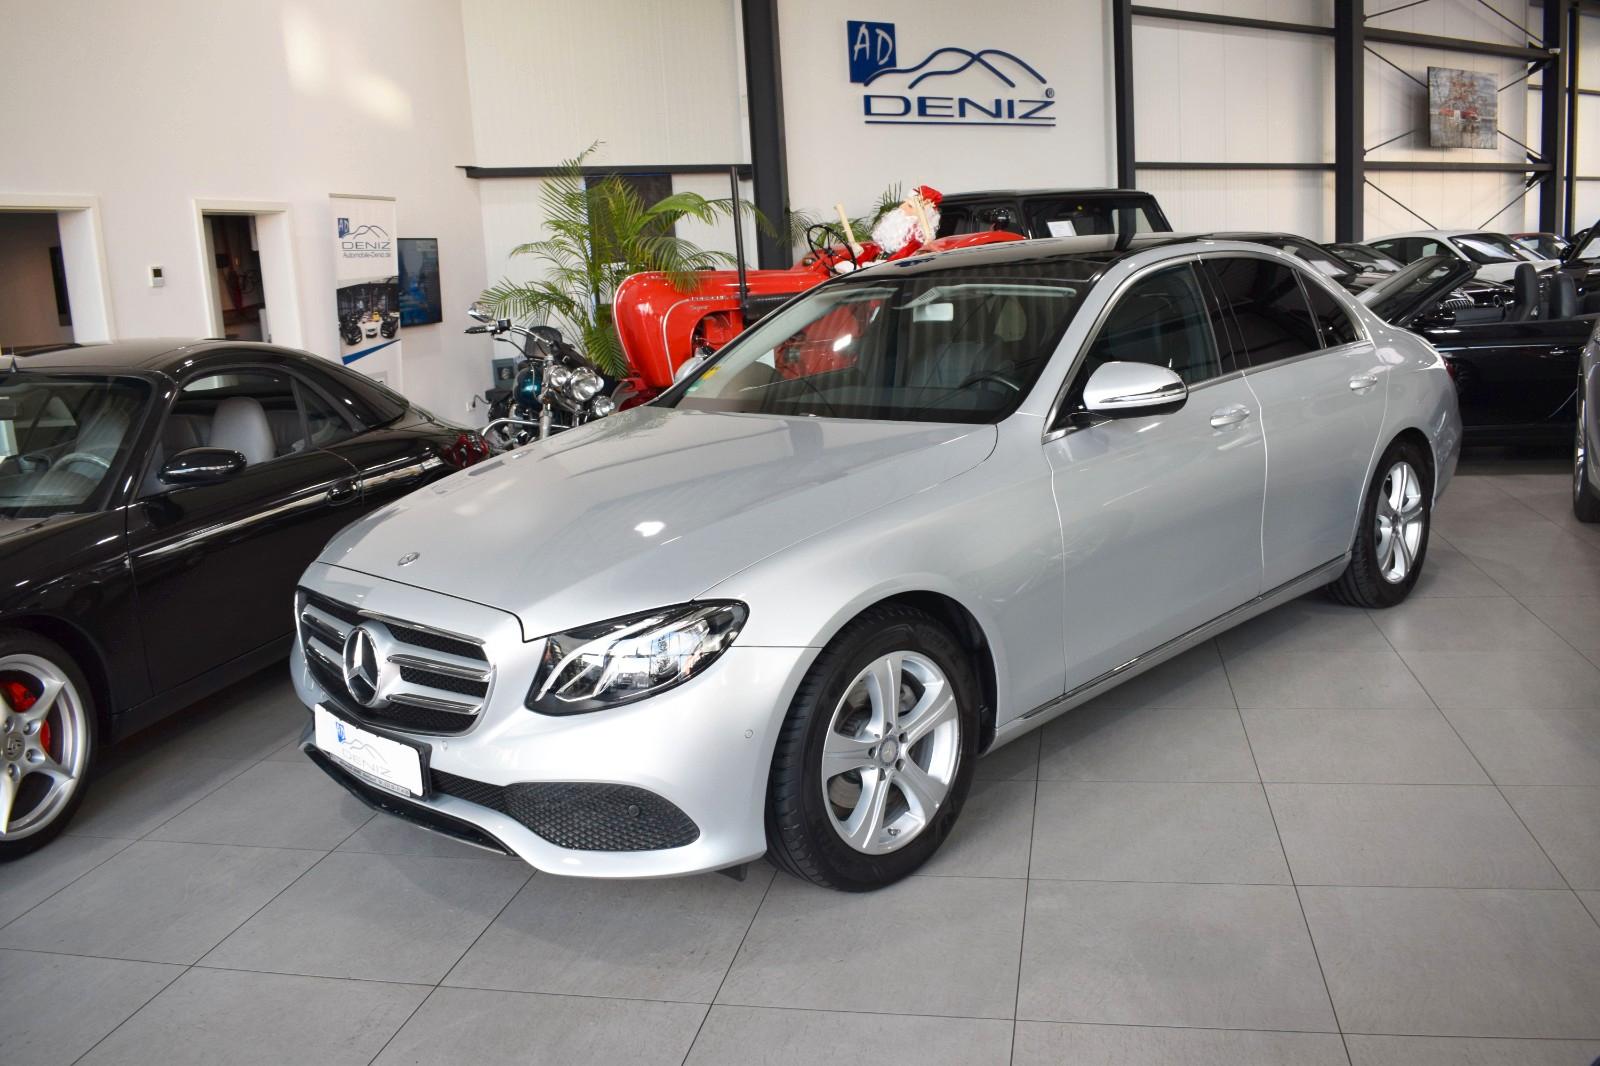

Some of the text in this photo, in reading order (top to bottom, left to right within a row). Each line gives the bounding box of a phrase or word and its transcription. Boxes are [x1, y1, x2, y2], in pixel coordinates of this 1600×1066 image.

[853, 23, 893, 65] AD
[863, 94, 1056, 120] DENIZ
[341, 241, 391, 250] DENIZ
